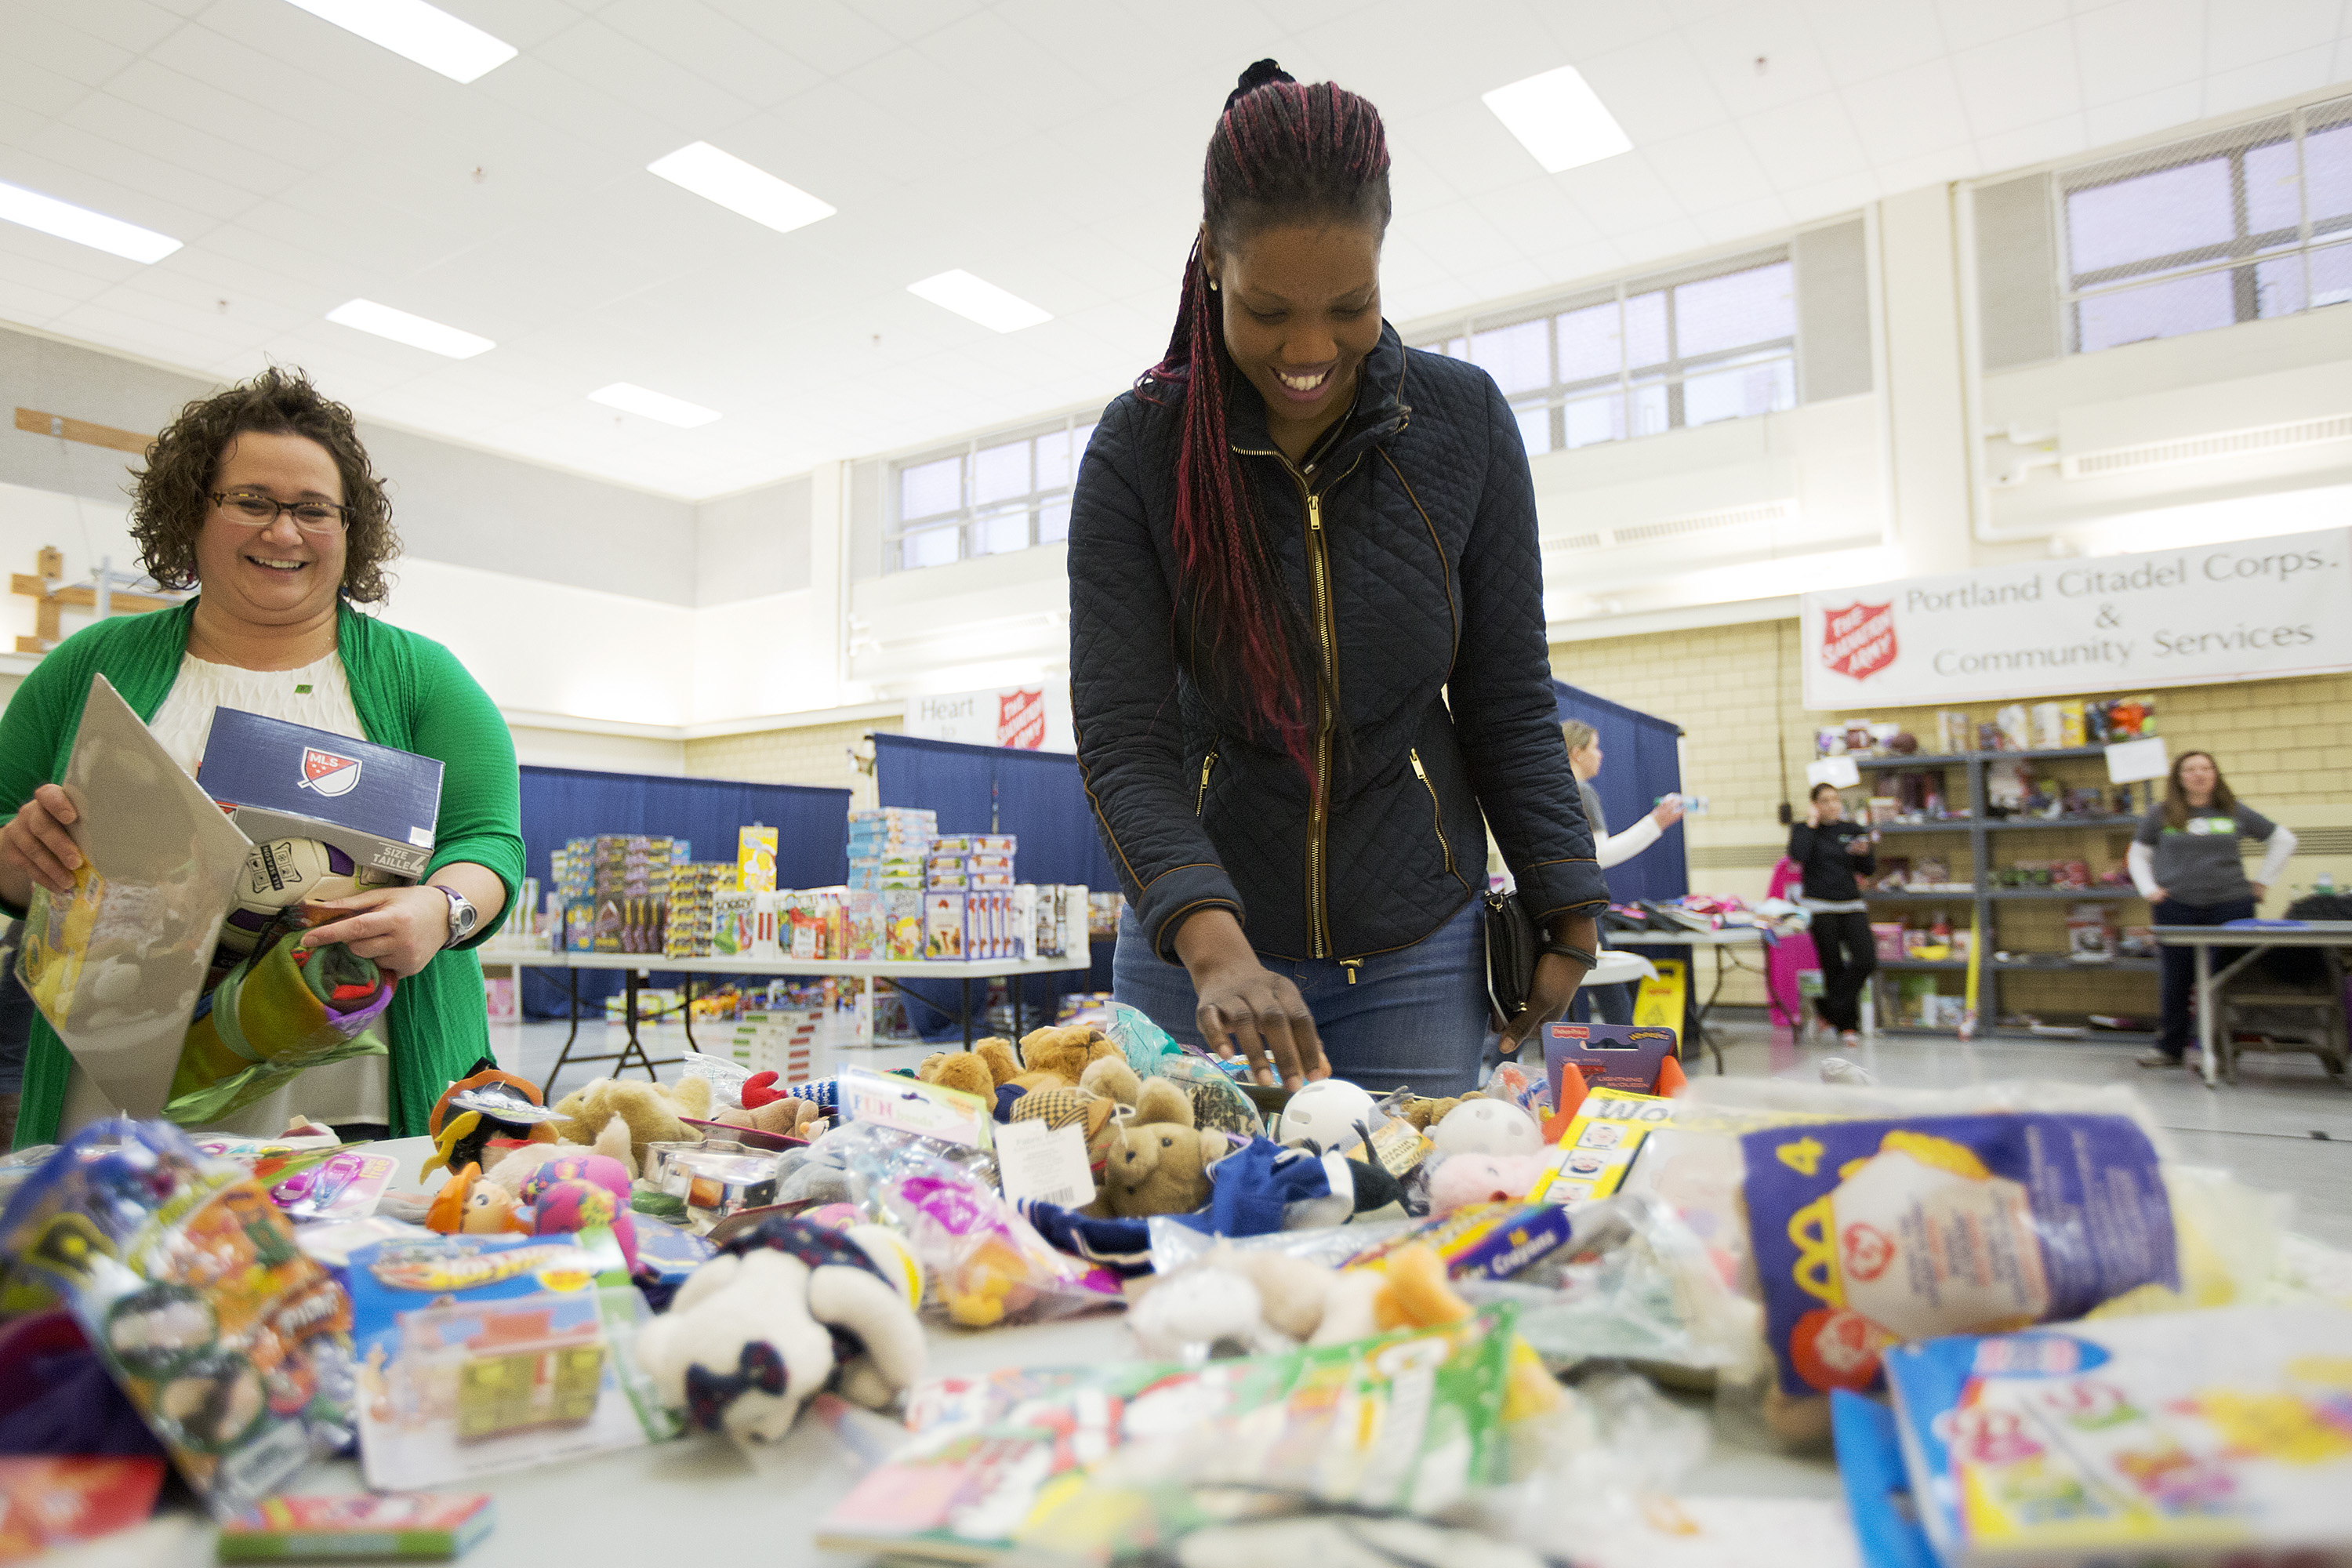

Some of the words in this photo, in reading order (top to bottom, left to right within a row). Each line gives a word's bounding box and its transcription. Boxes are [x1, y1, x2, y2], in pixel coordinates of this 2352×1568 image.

[1907, 575, 2042, 613] Portland
[2056, 558, 2186, 599] Citadel
[2202, 549, 2339, 583] Corps.
[2094, 604, 2120, 629] &
[1933, 638, 2134, 677] Community
[2153, 623, 2315, 659] Services
[921, 697, 974, 721] Heart
[309, 753, 339, 768] MLS
[263, 846, 278, 876] SEASON
[372, 853, 411, 870] TAILLE
[383, 847, 408, 861] SIZE
[410, 855, 426, 875] 4
[272, 874, 283, 891] ALL
[853, 1094, 893, 1116] FUN
[1492, 1229, 1558, 1276] Crayons
